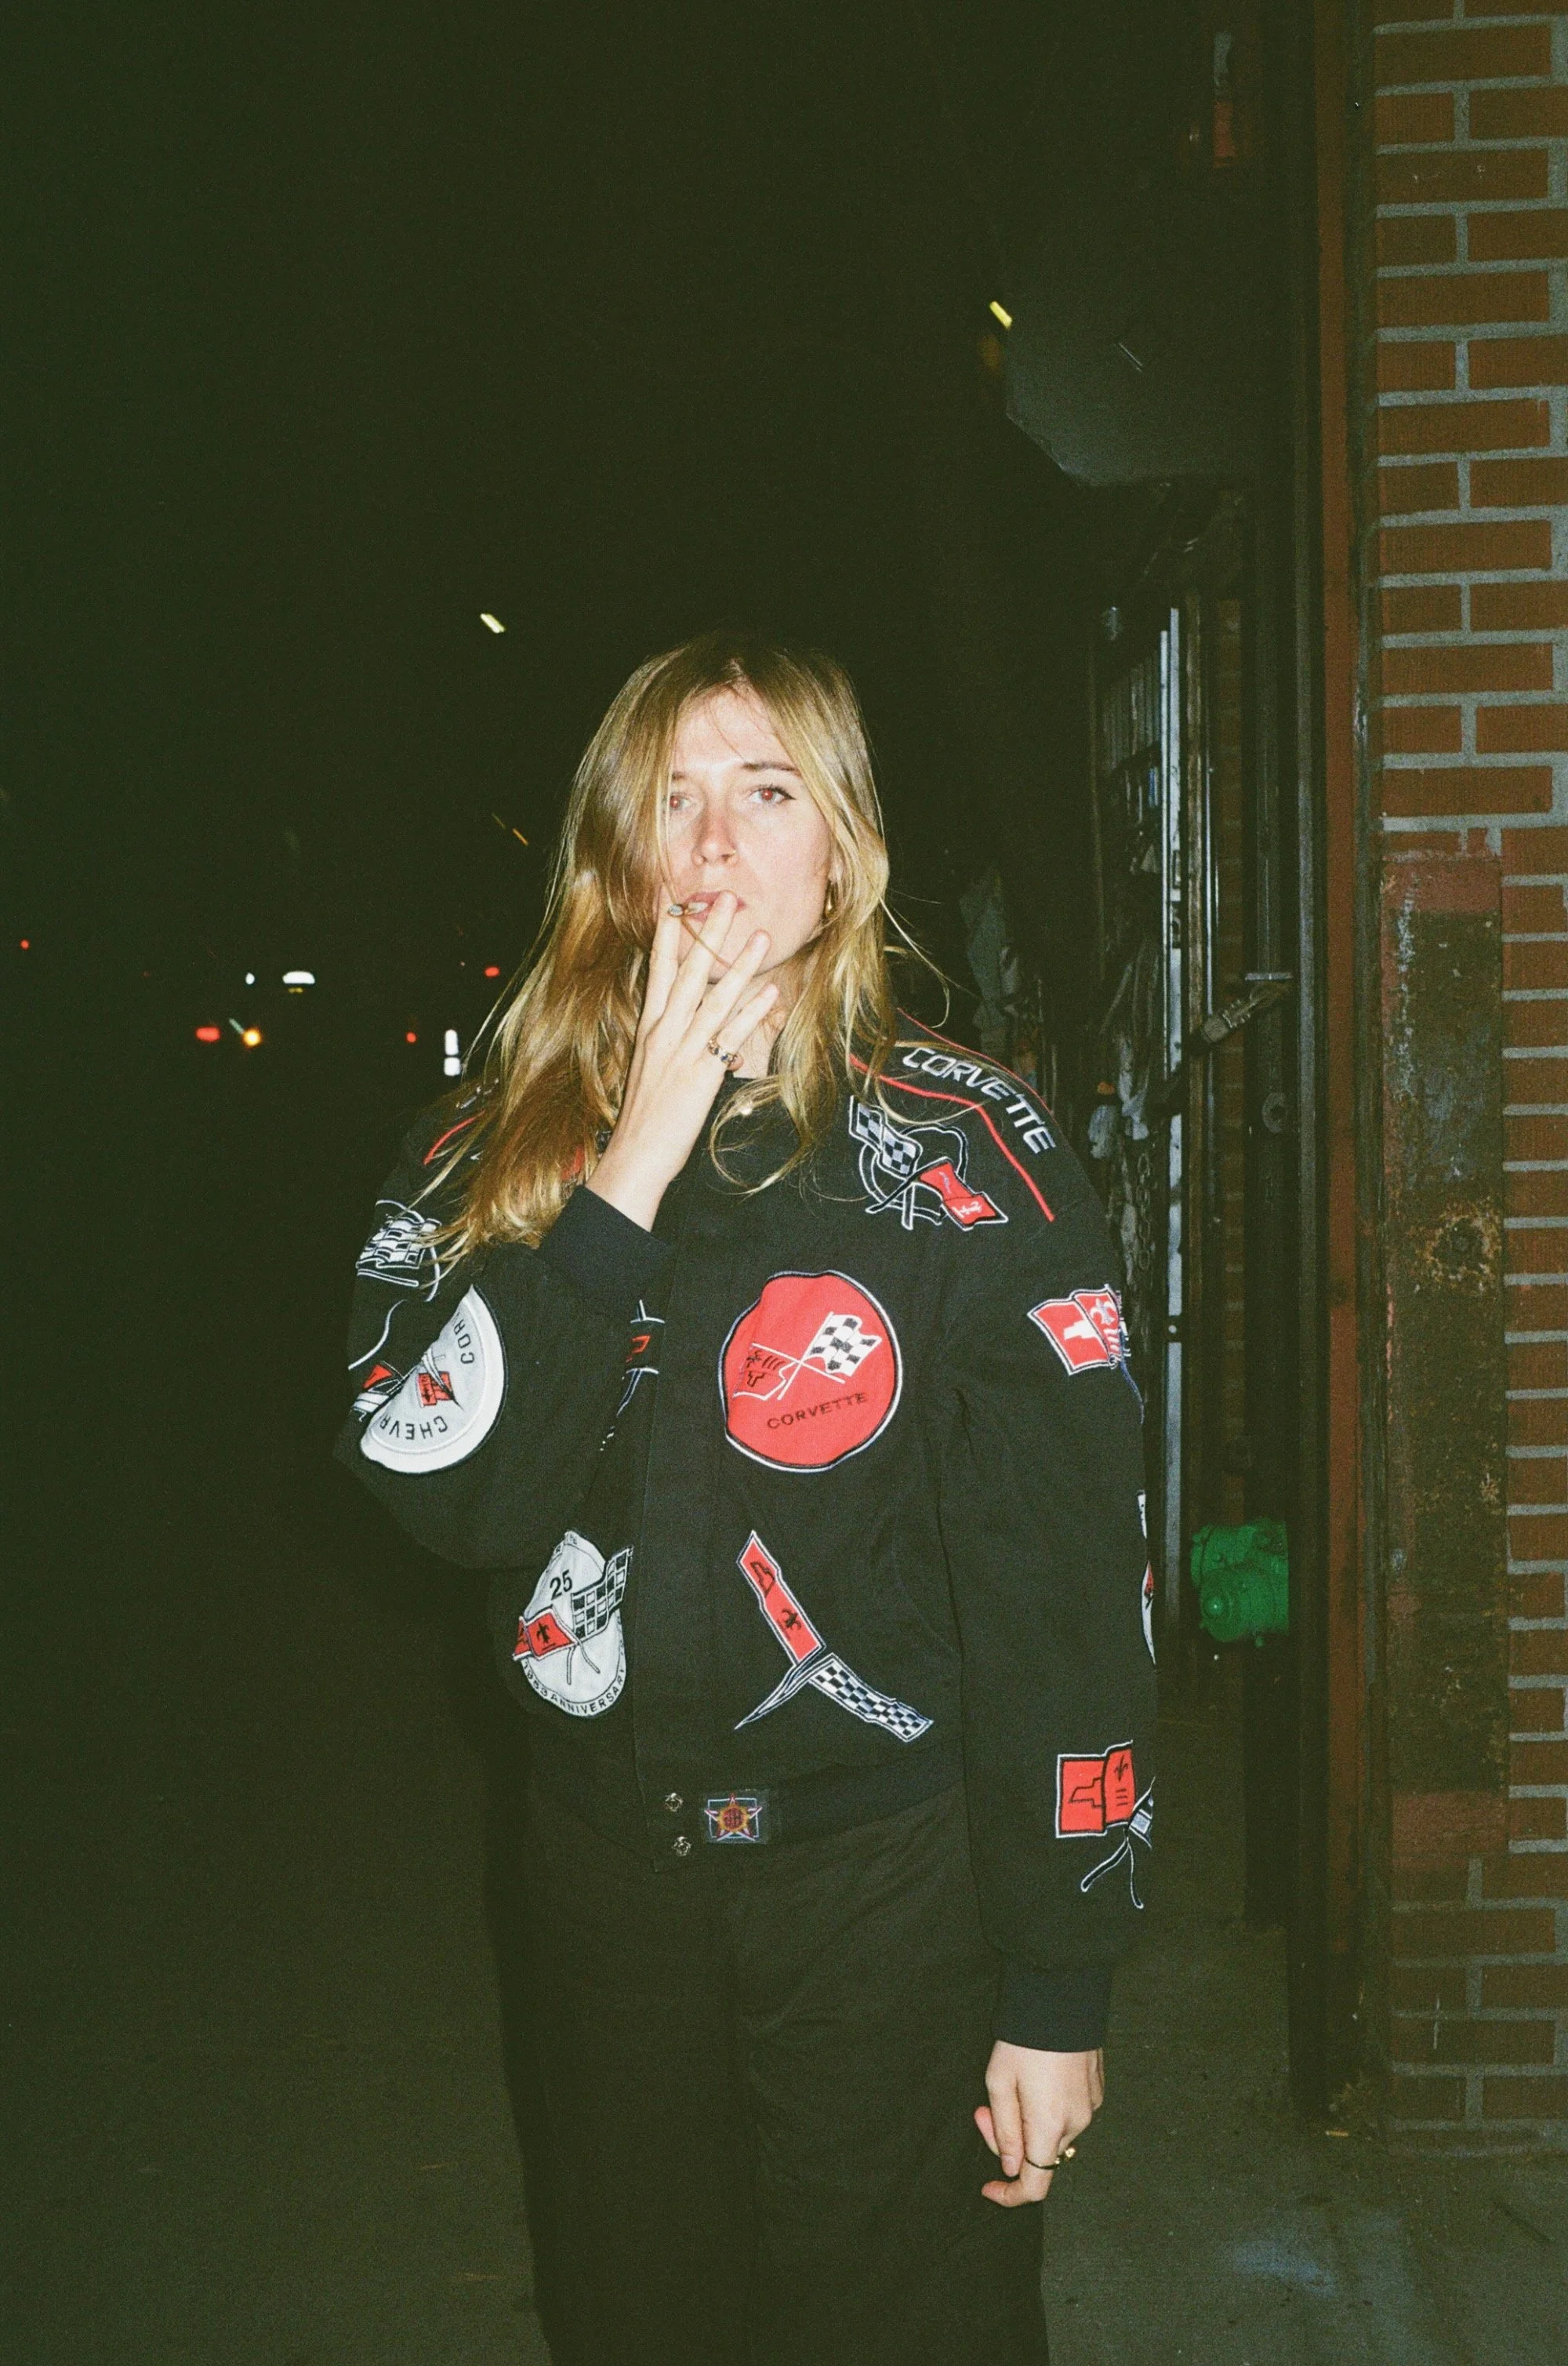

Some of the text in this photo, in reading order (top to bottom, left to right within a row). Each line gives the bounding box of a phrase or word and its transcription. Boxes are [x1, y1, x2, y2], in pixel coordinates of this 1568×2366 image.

[902, 1047, 1057, 1154] CORVETTE
[767, 1392, 869, 1430] CORVETTE
[550, 1568, 573, 1601] 25
